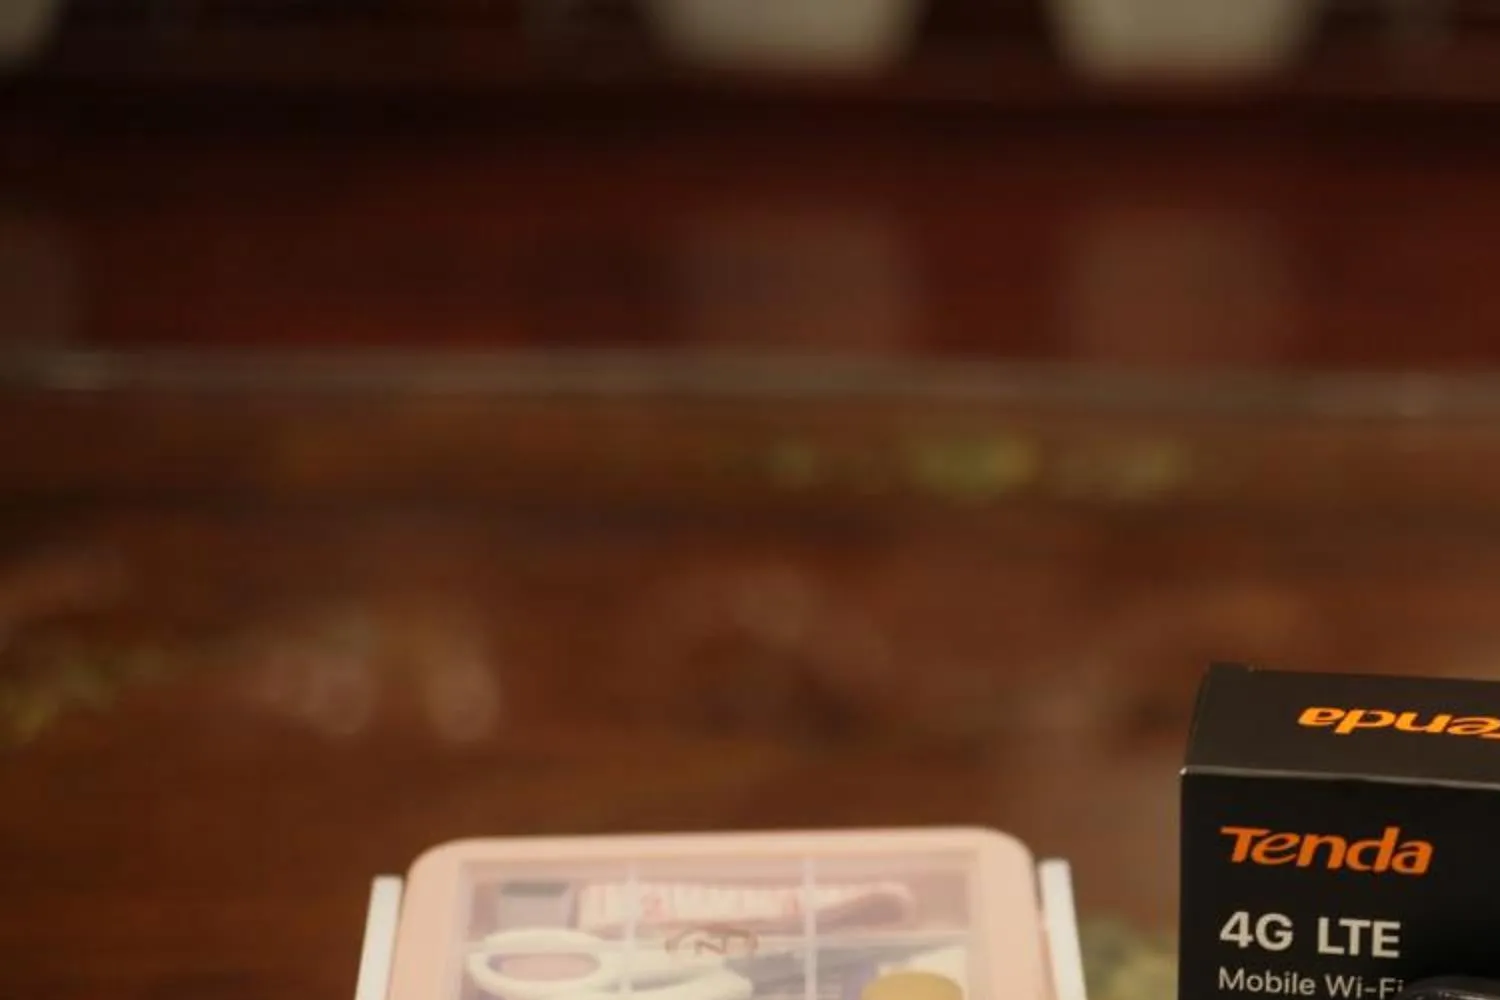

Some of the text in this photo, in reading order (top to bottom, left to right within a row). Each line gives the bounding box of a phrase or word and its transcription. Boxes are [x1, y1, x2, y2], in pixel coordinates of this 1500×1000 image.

[1219, 827, 1434, 875] Tenda
[1219, 911, 1400, 959] 4G LTE
[1218, 966, 1317, 996] Mobile
